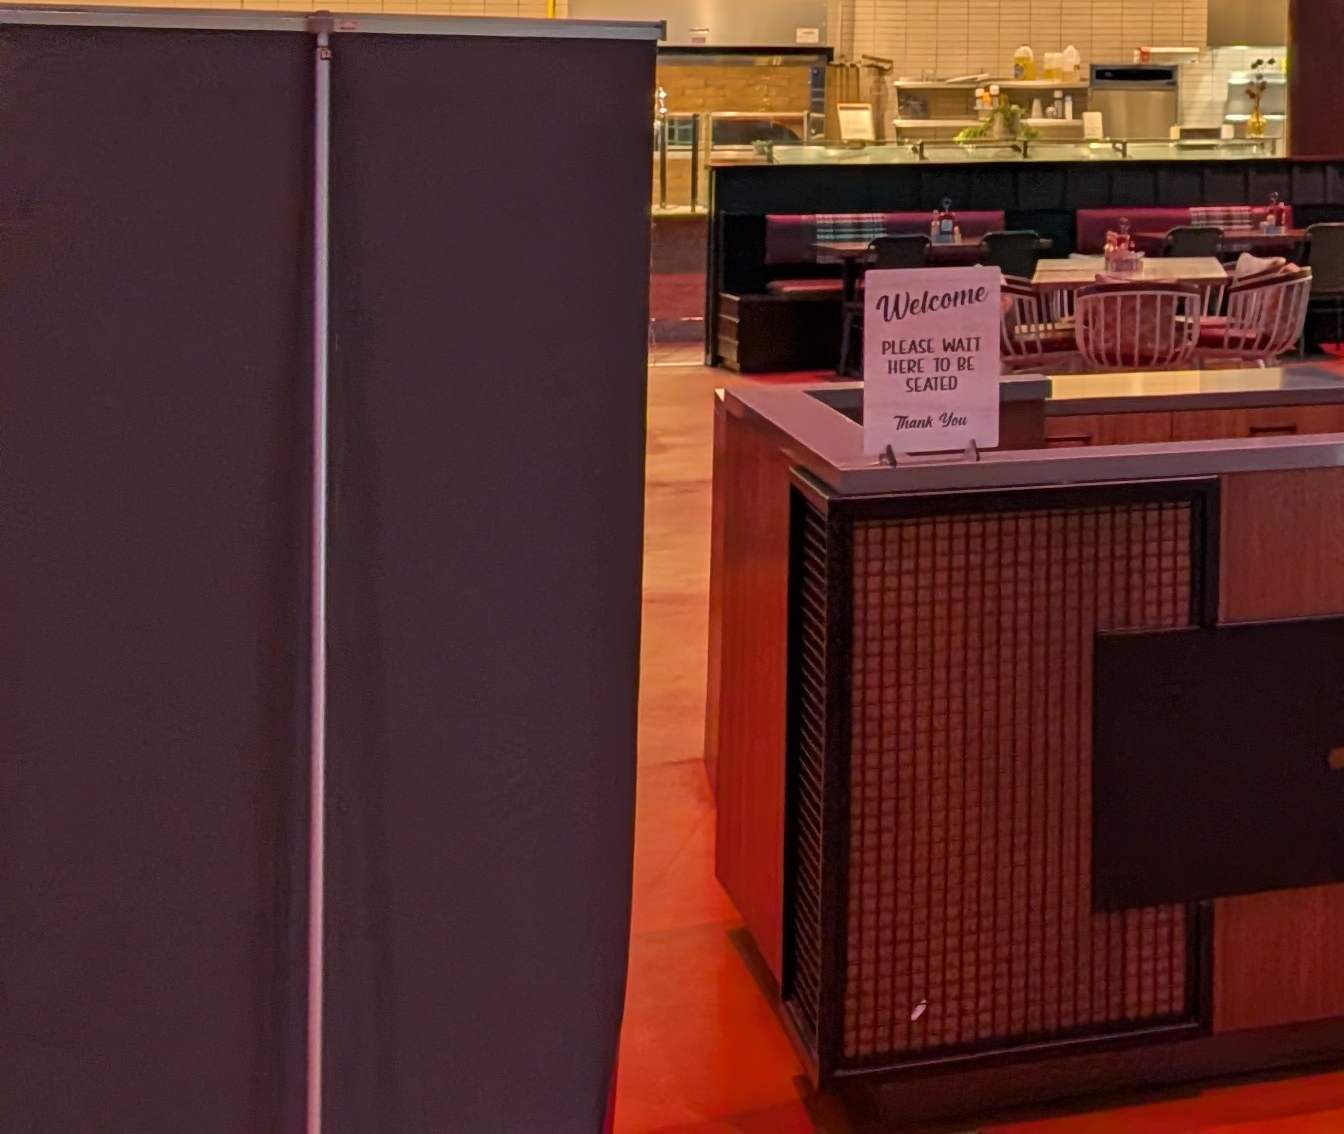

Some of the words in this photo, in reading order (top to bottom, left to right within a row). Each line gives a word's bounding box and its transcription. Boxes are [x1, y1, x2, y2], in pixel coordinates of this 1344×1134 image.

[876, 286, 989, 323] Welcome
[881, 339, 934, 356] PLEASE
[942, 336, 981, 353] WAIT
[887, 357, 925, 374] HERE
[935, 357, 950, 373] TO
[957, 356, 975, 371] BE
[905, 375, 958, 393] SEATED
[893, 415, 933, 431] Thank
[939, 412, 967, 428] You
